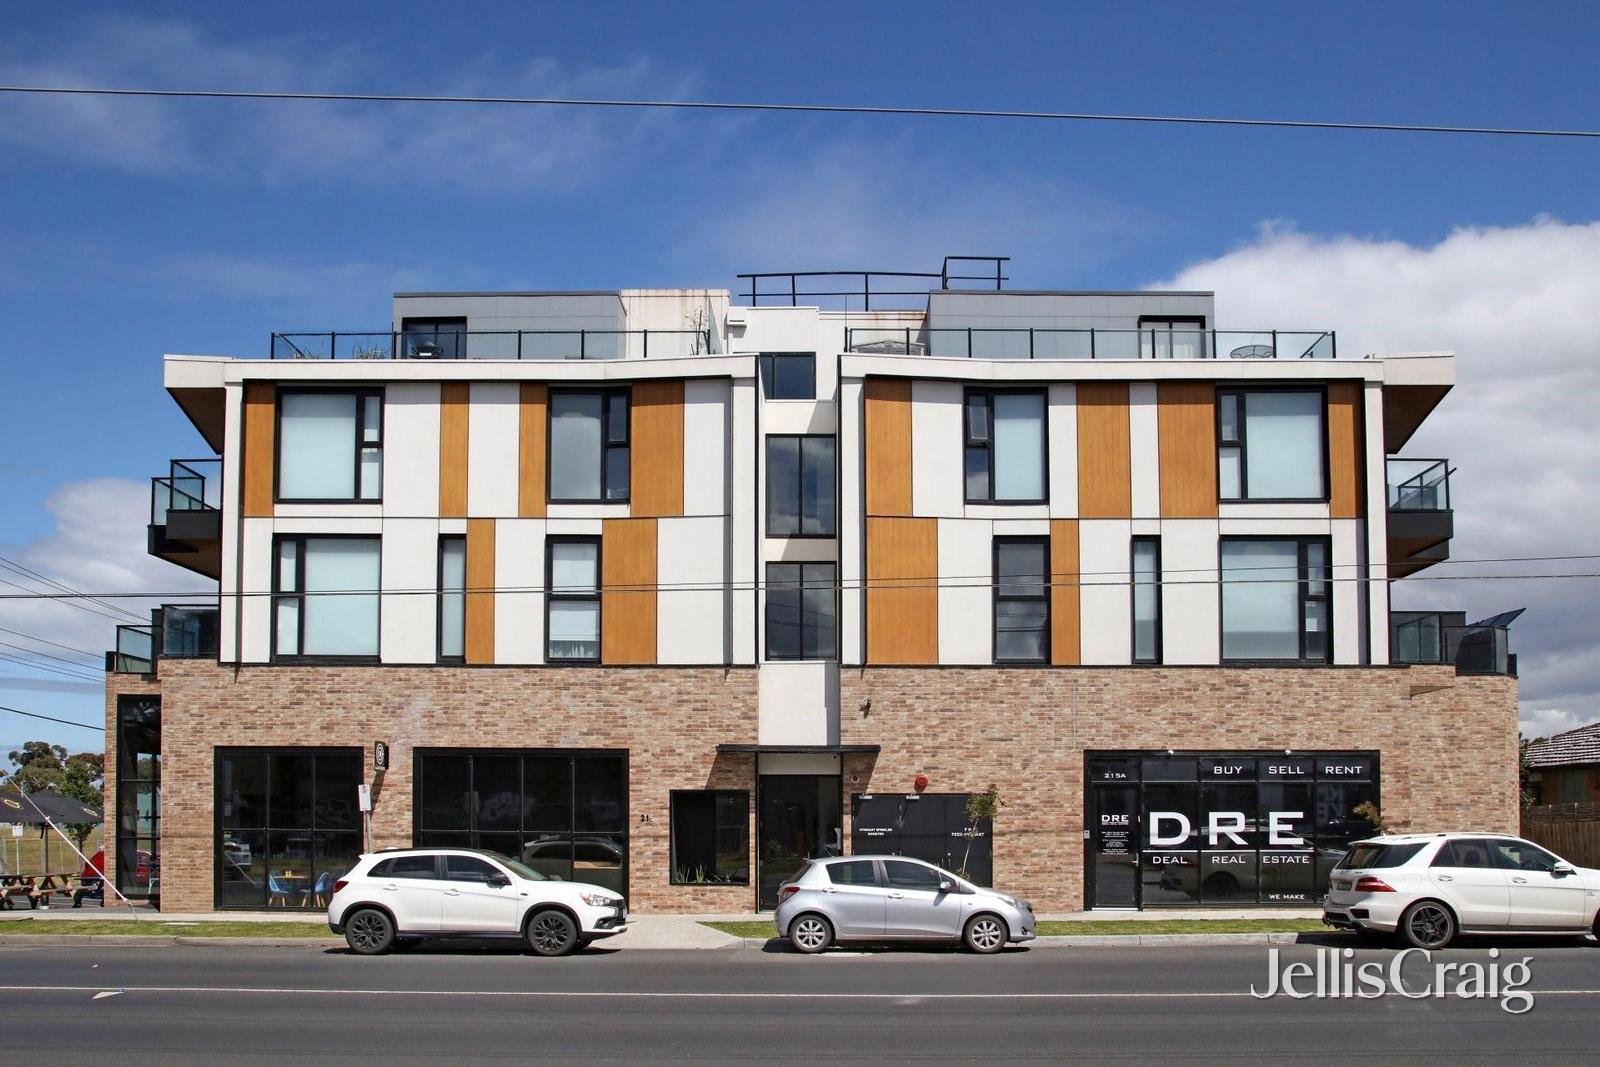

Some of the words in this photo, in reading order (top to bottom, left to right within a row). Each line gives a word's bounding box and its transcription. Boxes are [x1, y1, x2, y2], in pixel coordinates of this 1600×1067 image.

[1213, 766, 1243, 775] BUY
[1268, 766, 1305, 775] SELL
[1325, 766, 1363, 775] RENT
[1101, 814, 1129, 822] DRE
[1149, 811, 1304, 846] DRE
[1152, 856, 1188, 864] DEAL
[1211, 856, 1246, 864] REAL
[1262, 855, 1310, 864] ESTATE
